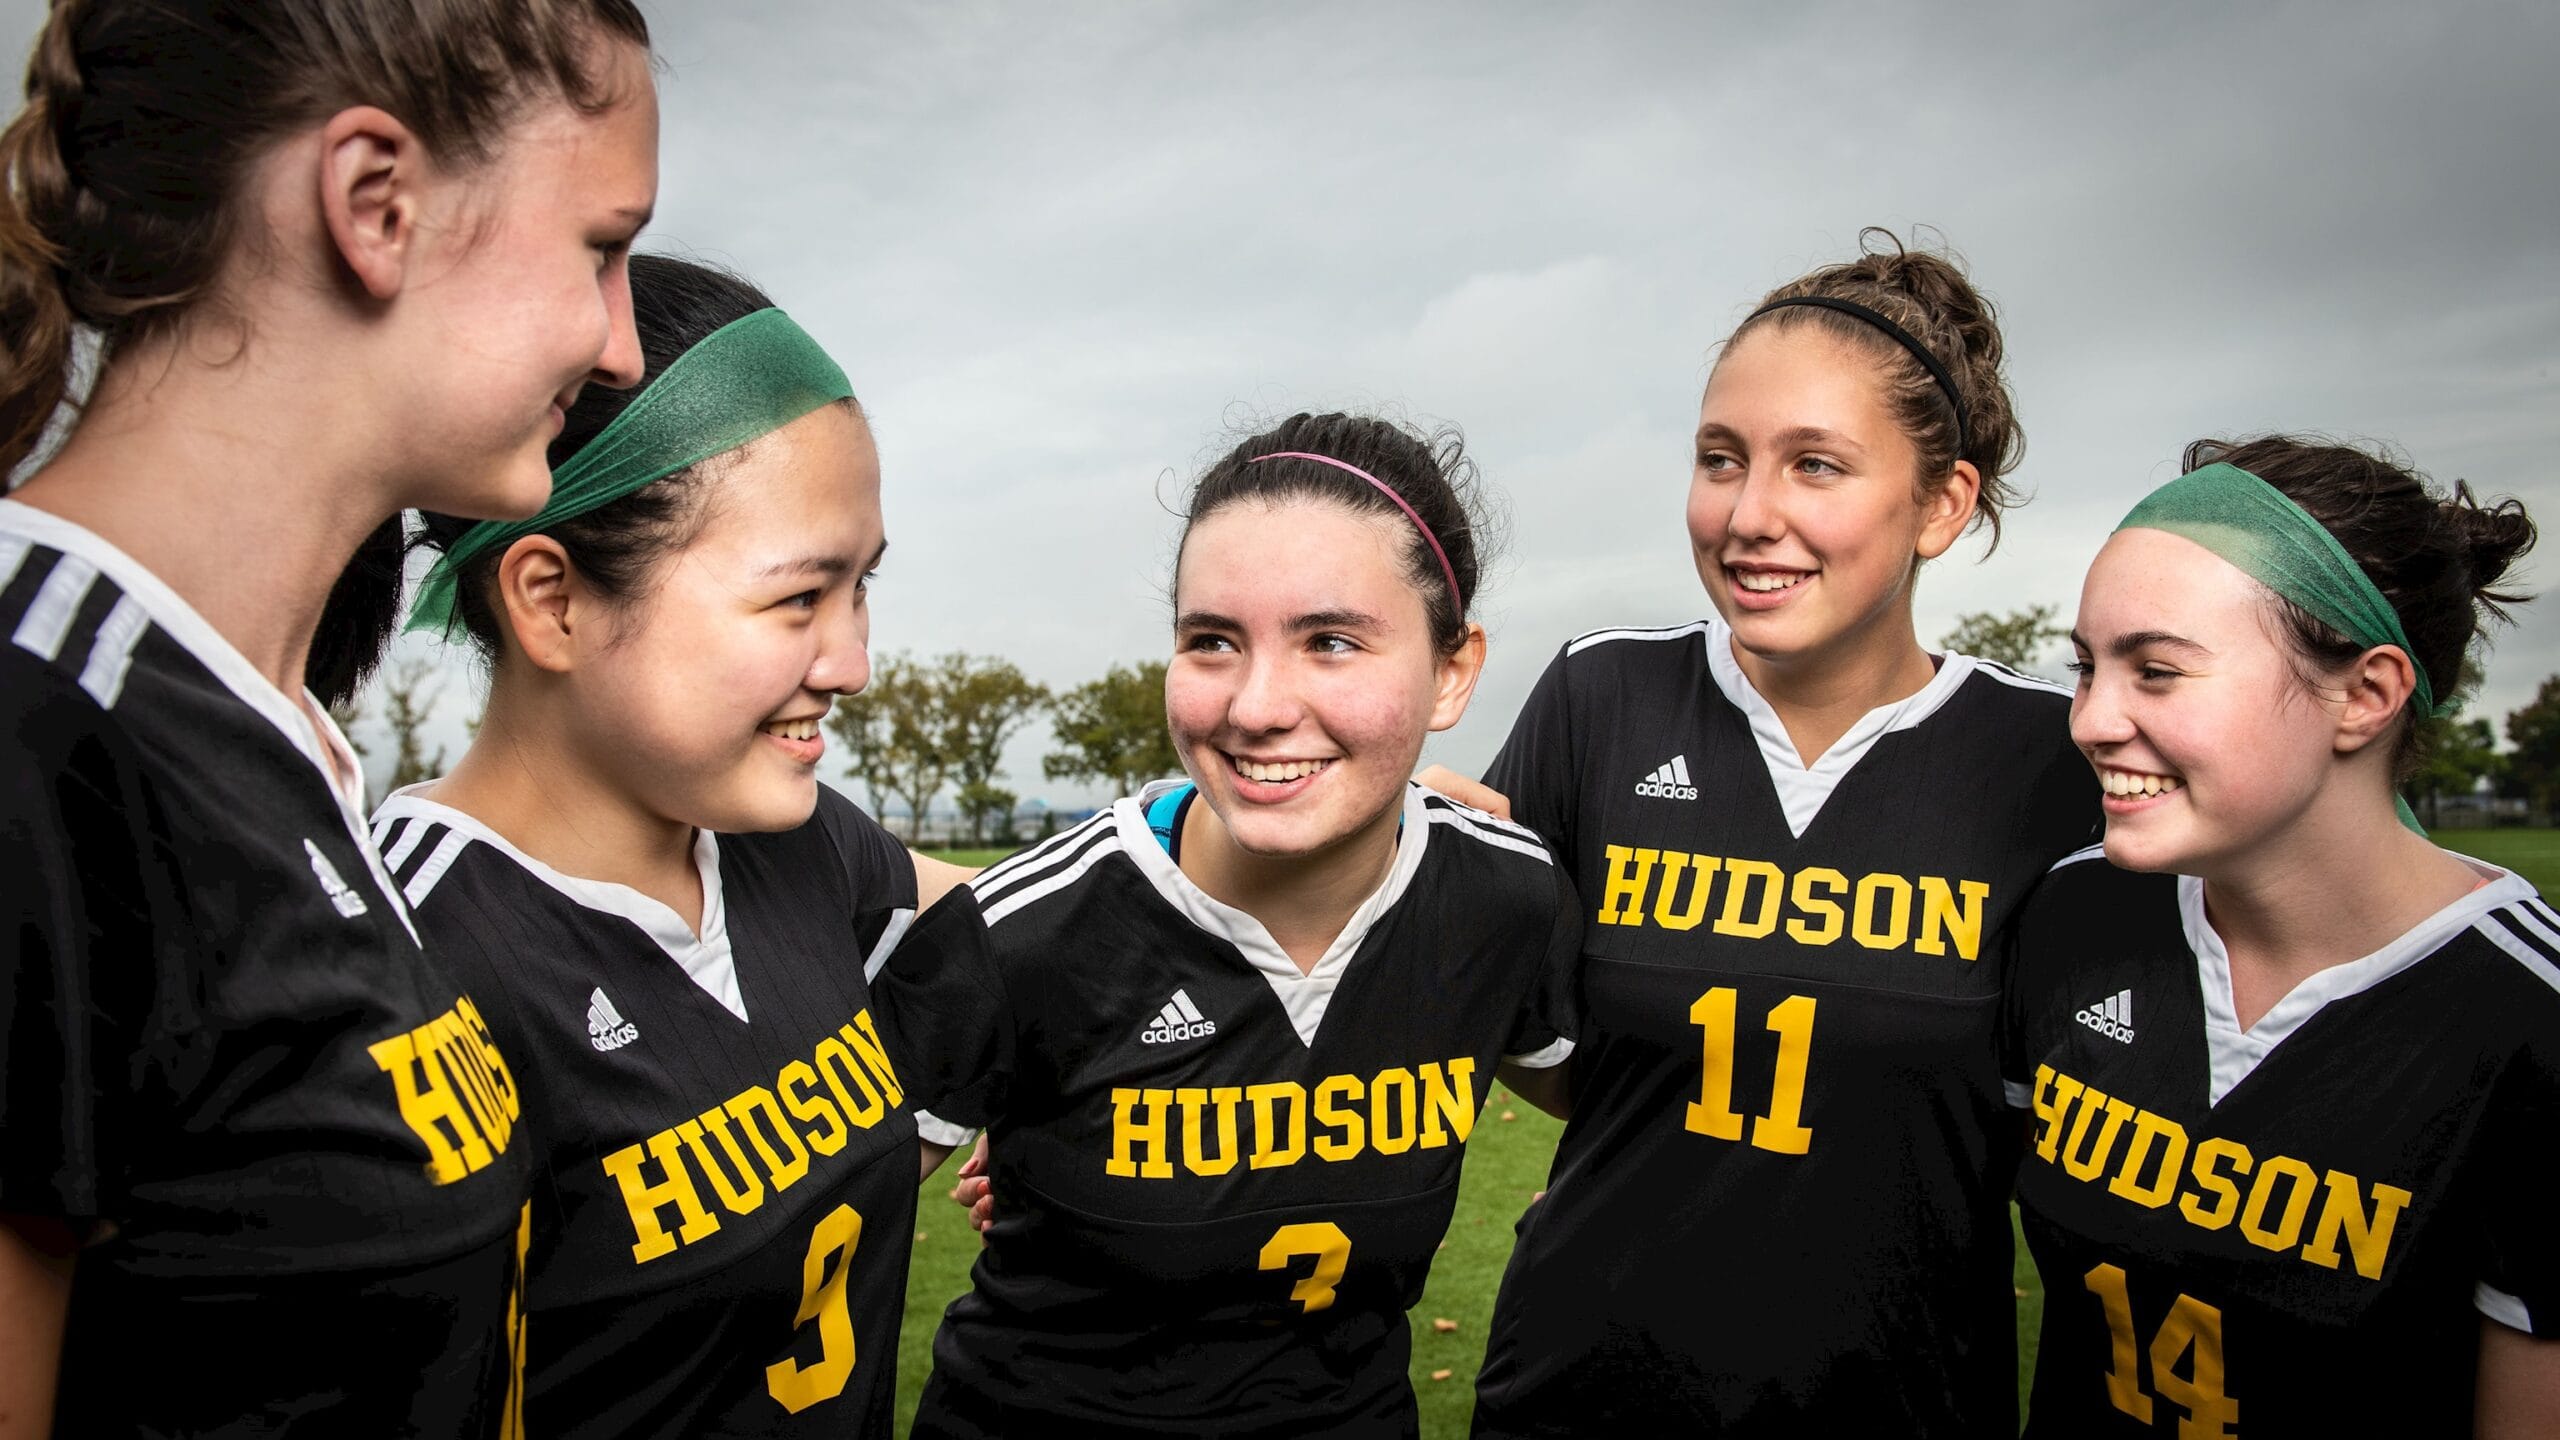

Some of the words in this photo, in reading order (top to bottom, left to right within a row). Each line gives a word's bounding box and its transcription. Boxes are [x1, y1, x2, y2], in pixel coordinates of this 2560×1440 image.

[1635, 782, 1699, 801] adidas
[1597, 844, 1990, 961] HUDSON
[591, 1023, 639, 1052] adidas
[1141, 1020, 1217, 1044] adidas
[1684, 986, 1817, 1155] 11
[2075, 1009, 2135, 1044] adidas
[602, 1007, 905, 1265] HUDSON
[1105, 1056, 1477, 1179] HUDSON
[2032, 1063, 2413, 1281] HUDSON
[765, 1203, 863, 1414] 9
[2084, 1261, 2240, 1440] 14
